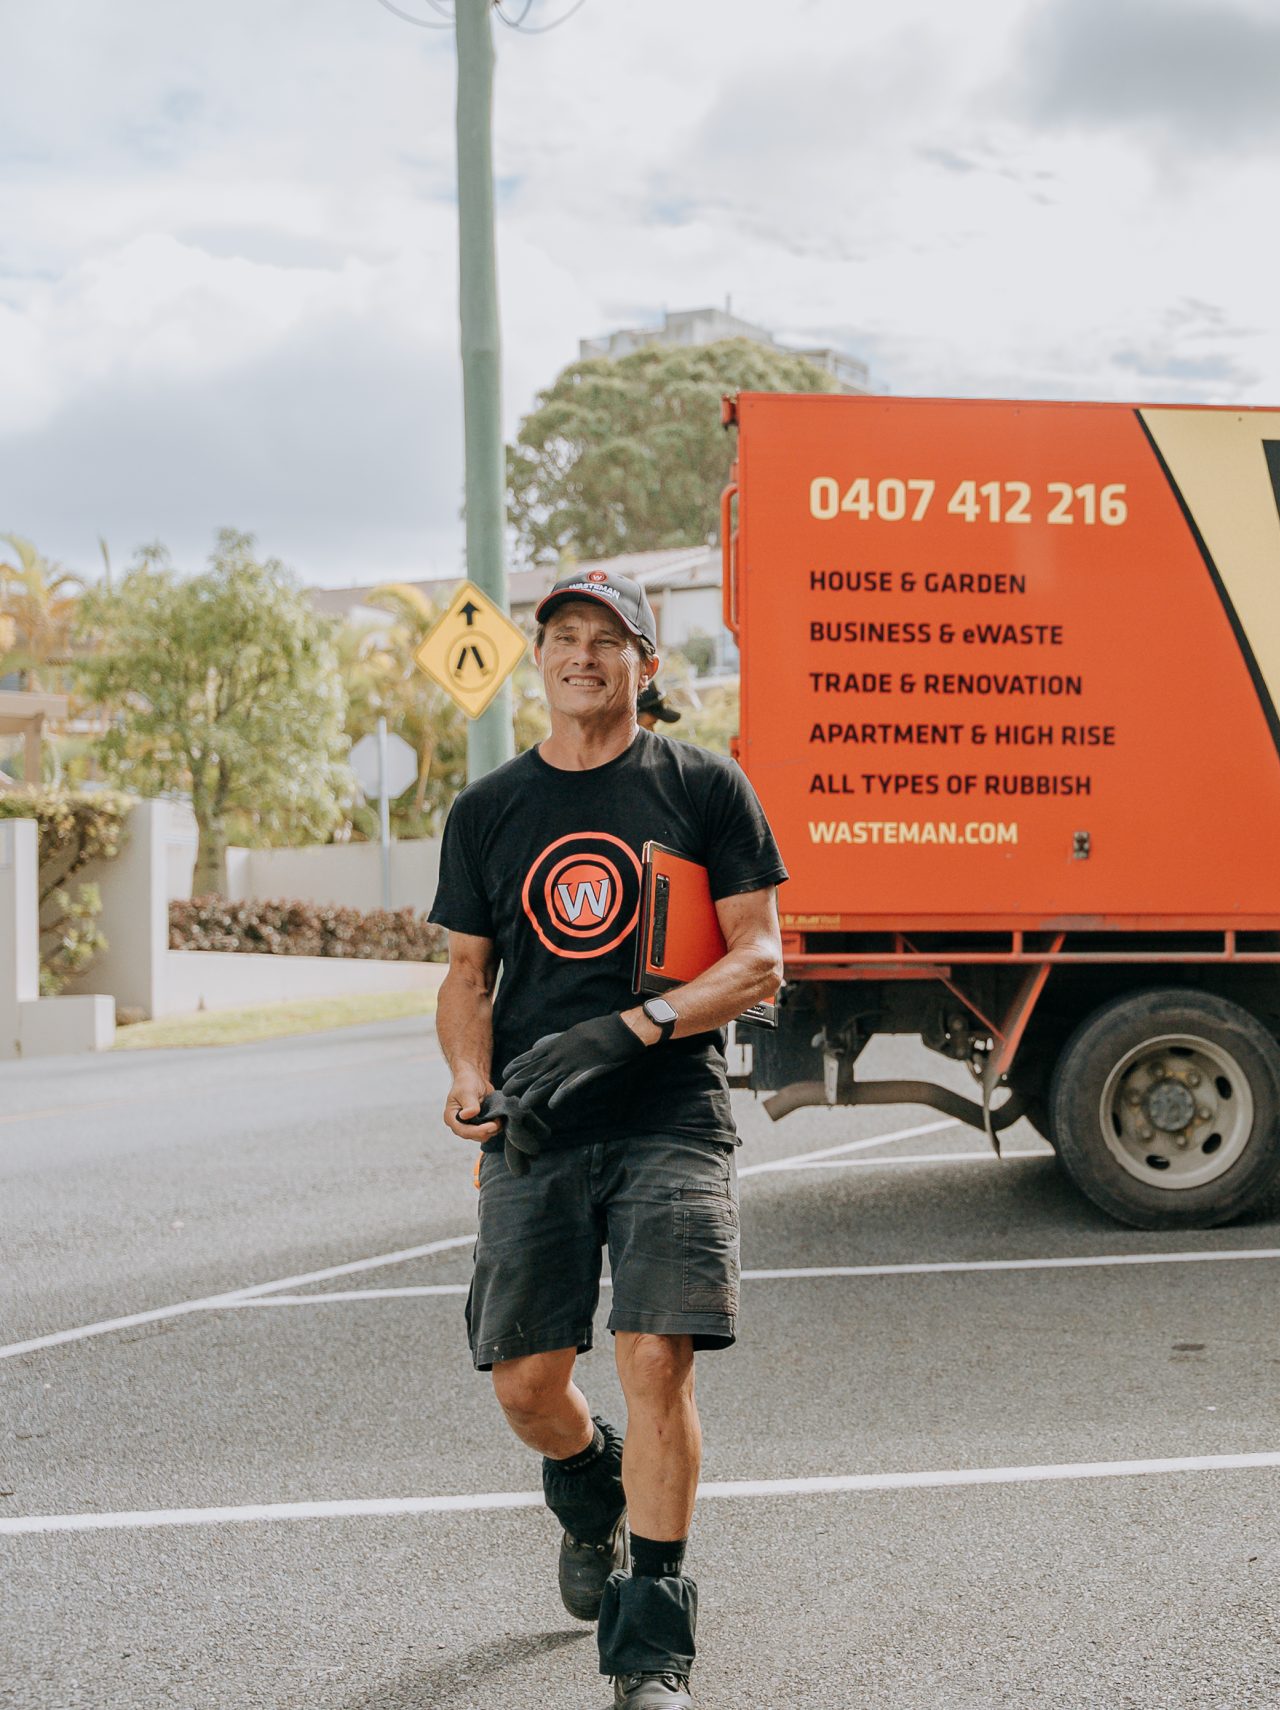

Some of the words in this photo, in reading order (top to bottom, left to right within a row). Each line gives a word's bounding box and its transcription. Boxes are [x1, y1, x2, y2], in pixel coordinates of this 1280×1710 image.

[810, 476, 936, 521] 0407
[947, 480, 1032, 524] 412
[1047, 482, 1128, 526] 216
[809, 570, 893, 593] HOUSE
[901, 572, 917, 593] &
[924, 573, 1026, 594] GARDEN
[809, 621, 932, 644] BUSINESS
[939, 623, 956, 645] &
[962, 624, 1064, 646] eWASTE
[809, 671, 892, 694] TRADE
[900, 673, 917, 694] &
[924, 674, 1083, 696] RENOVATION
[809, 723, 964, 745] APARTMENT
[971, 725, 988, 746] &
[995, 725, 1054, 746] HIGH
[1061, 726, 1116, 746] RISE
[809, 773, 855, 795] ALL
[862, 774, 940, 796] TYPES
[946, 774, 978, 796] OF
[985, 775, 1092, 797] RUBBISH
[808, 821, 1018, 845] WASTEMAN.COM
[557, 878, 610, 923] W
